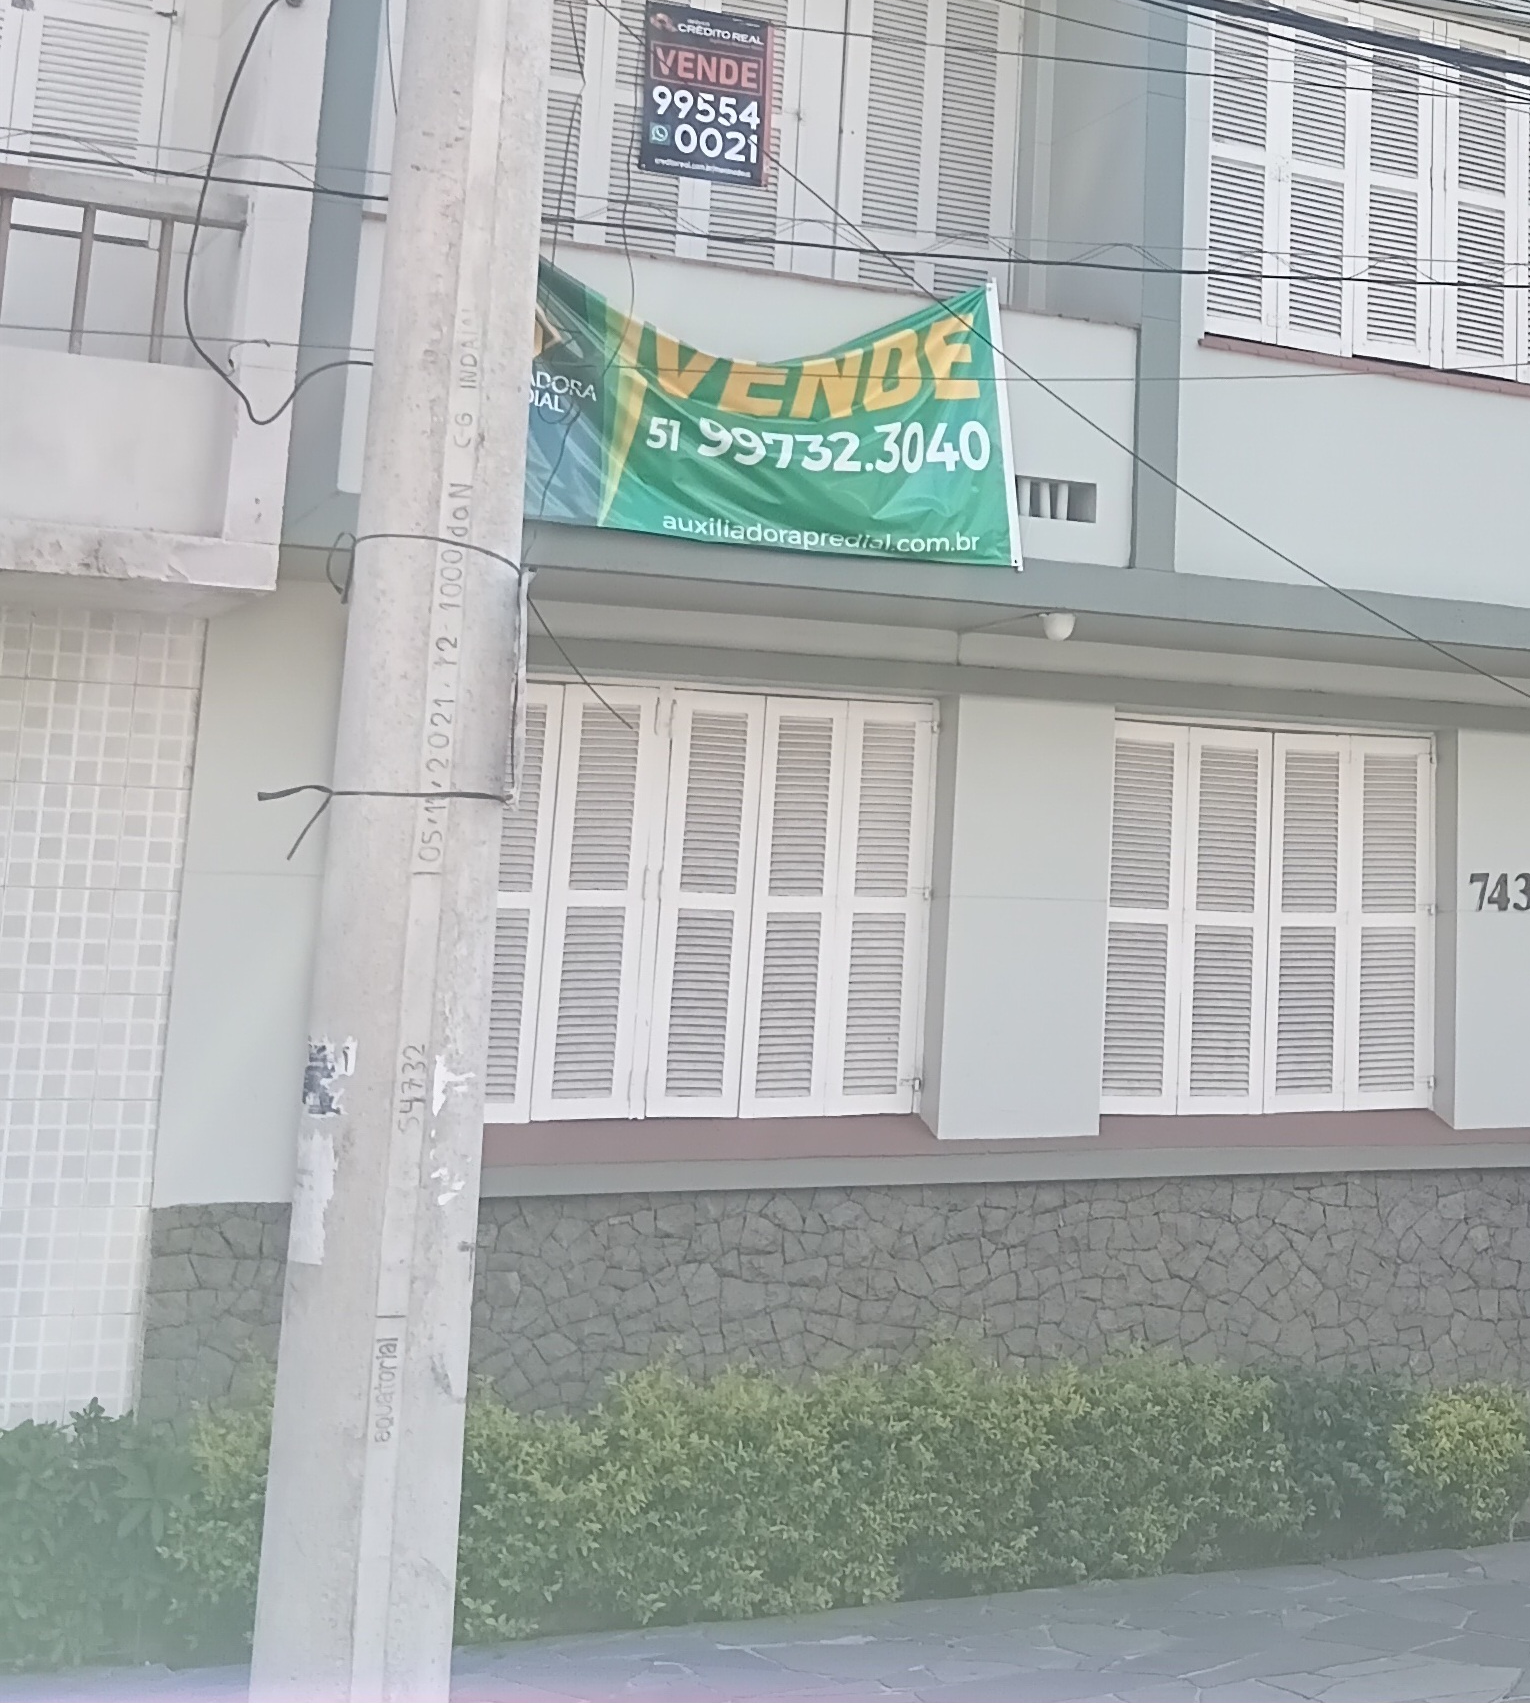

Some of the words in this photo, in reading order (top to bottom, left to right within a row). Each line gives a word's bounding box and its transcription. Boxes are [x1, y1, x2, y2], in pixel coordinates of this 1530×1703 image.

[677, 22, 731, 40] CRÉDITO
[732, 32, 764, 46] REAL
[655, 46, 759, 89] VENDE
[652, 85, 760, 130] 99554
[674, 123, 758, 164] 0021
[656, 313, 981, 418] VENDE
[646, 416, 681, 452] 51
[697, 416, 991, 473] 99732.3040
[662, 514, 980, 553] auxiliadorapredial.com.br
